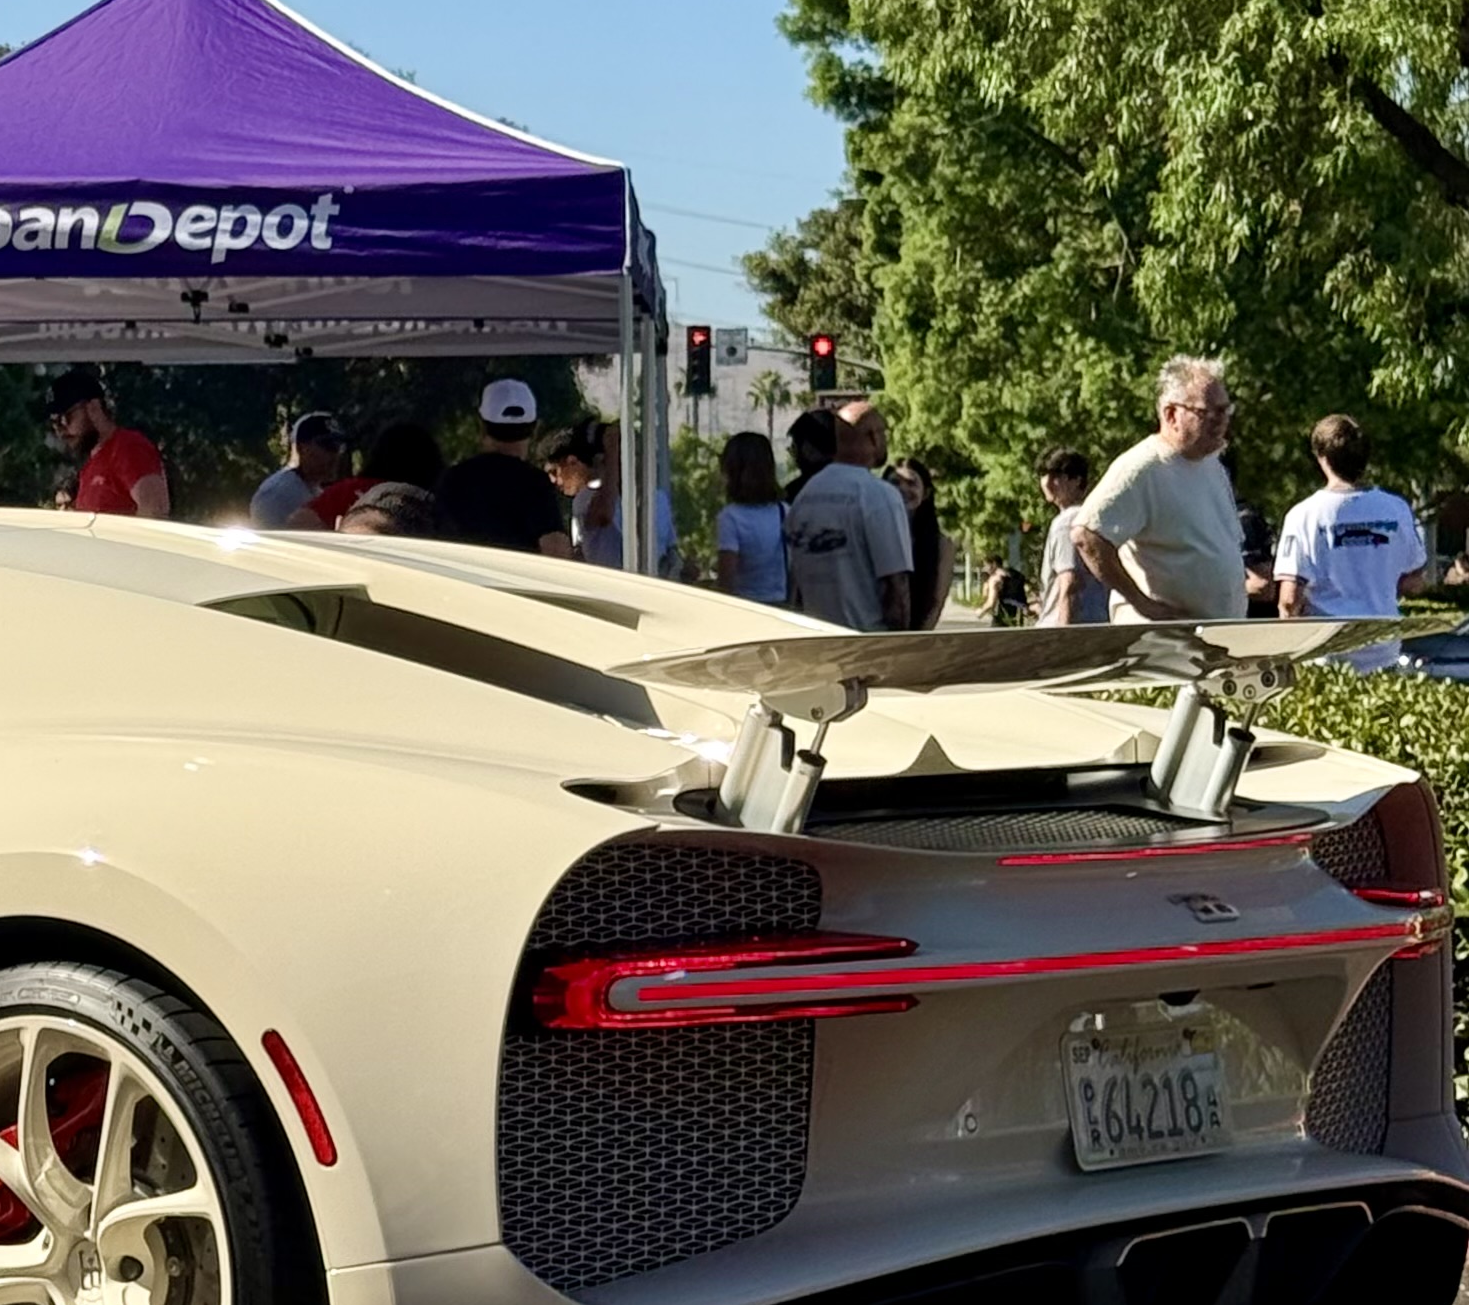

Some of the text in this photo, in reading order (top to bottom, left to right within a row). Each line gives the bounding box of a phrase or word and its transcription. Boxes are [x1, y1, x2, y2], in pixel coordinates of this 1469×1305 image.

[1072, 1045, 1091, 1064] SEP
[174, 1056, 246, 1182] MICHELIN
[1104, 1066, 1204, 1144] 64218
